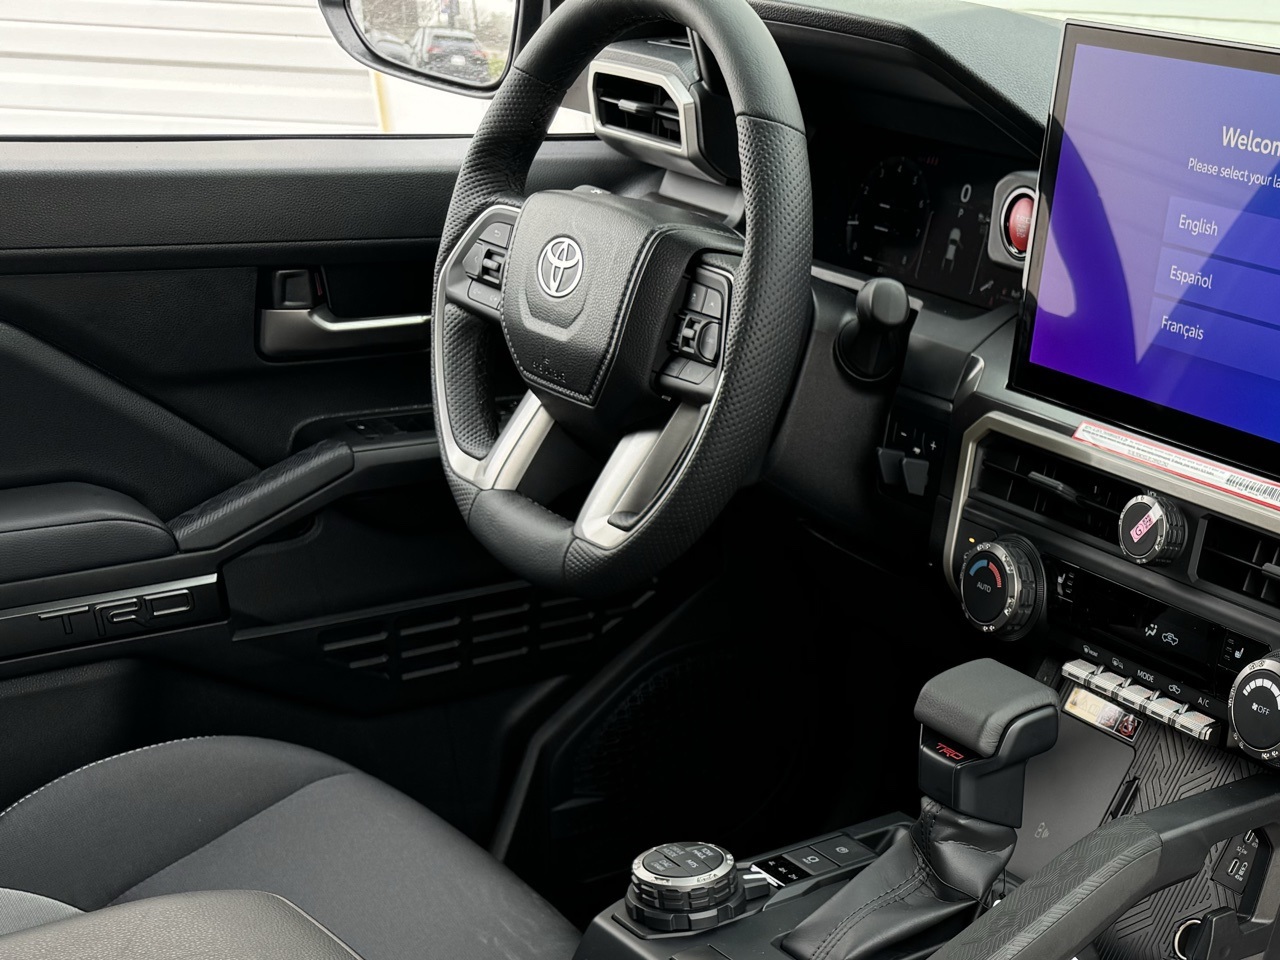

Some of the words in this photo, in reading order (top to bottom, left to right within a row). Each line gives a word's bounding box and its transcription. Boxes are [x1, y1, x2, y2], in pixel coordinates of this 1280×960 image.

[1188, 158, 1219, 176] Please
[1220, 165, 1248, 182] select
[1248, 172, 1272, 186] your
[960, 184, 972, 203] 0
[1179, 214, 1218, 236] English
[1170, 265, 1212, 289] Español
[1161, 315, 1204, 340] Français
[976, 581, 992, 593] AUTO
[38, 588, 194, 636] TRD
[1137, 669, 1155, 683] MODE
[1197, 696, 1210, 708] A/C
[1258, 706, 1271, 716] OFF
[936, 742, 964, 760] TRD
